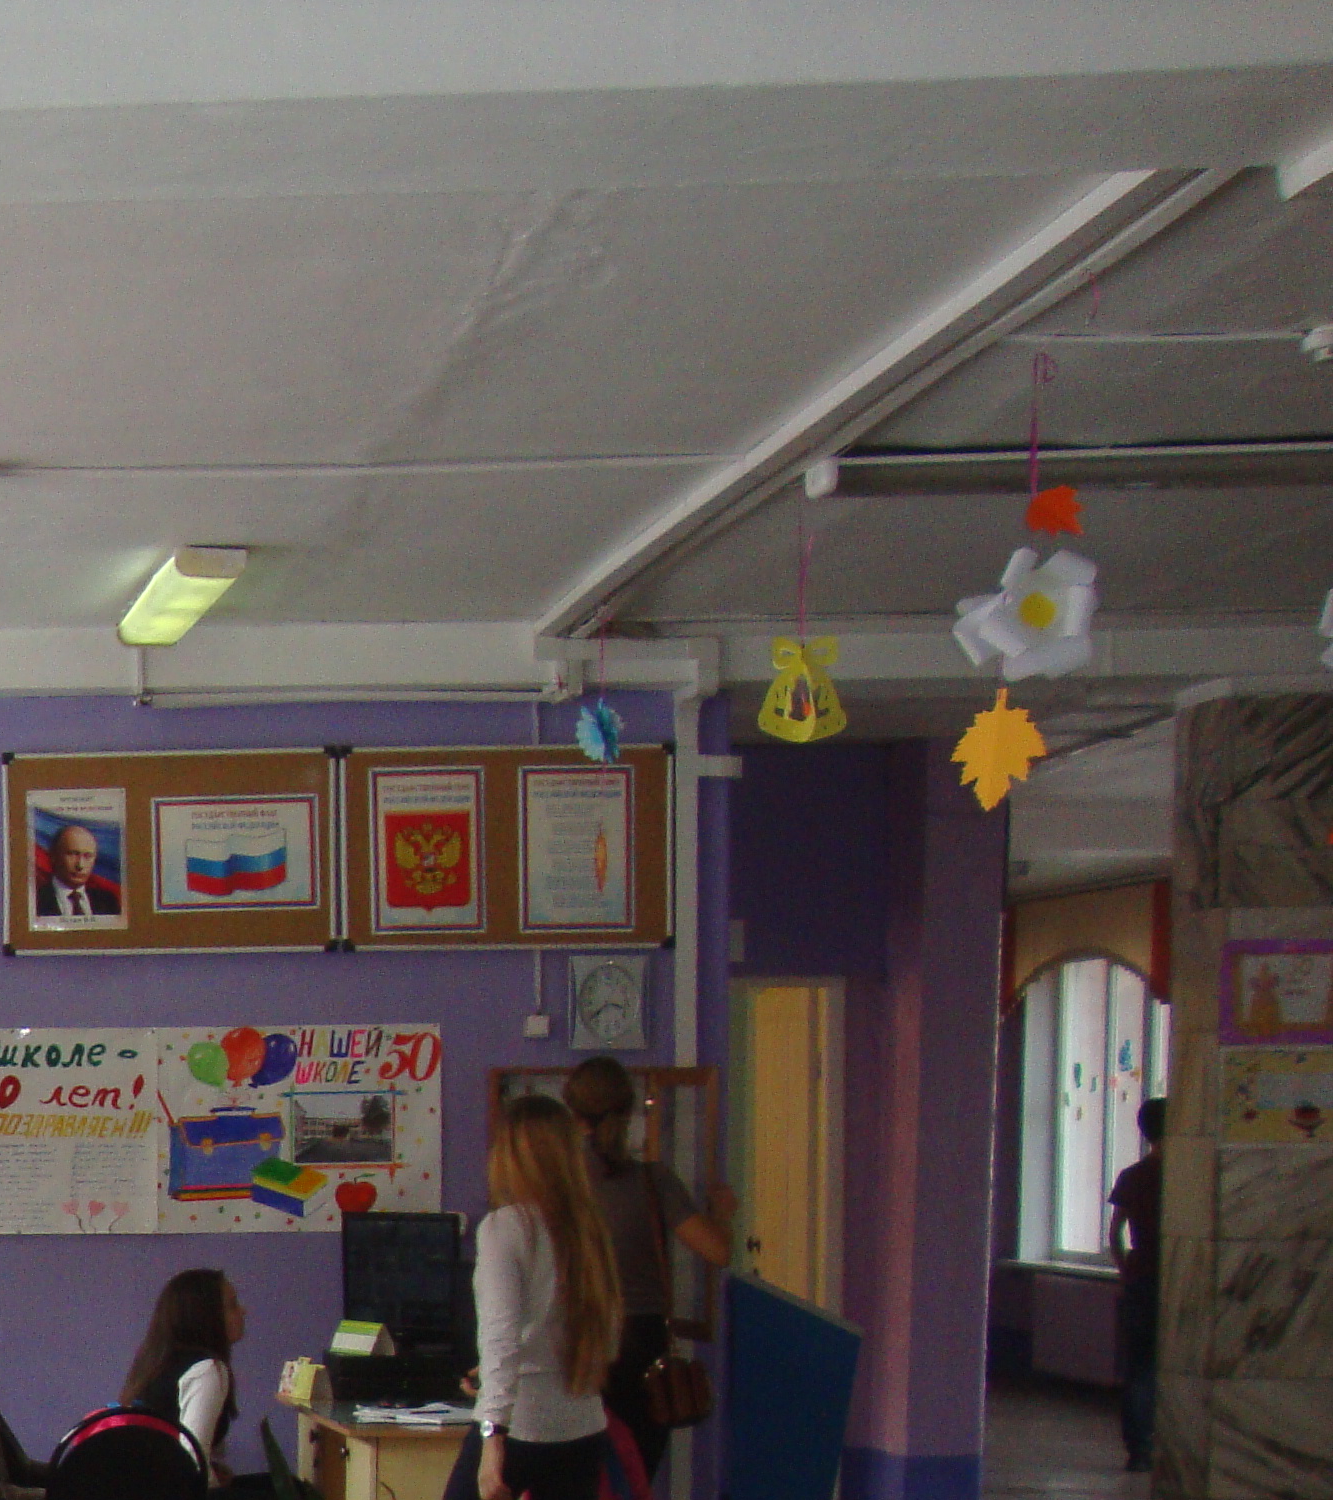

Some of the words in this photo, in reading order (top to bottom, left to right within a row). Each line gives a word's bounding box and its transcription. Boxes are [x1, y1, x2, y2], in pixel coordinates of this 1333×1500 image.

[298, 1026, 384, 1058] НАШЕЙ
[378, 1031, 443, 1082] 50
[40, 1073, 146, 1111] лет!
